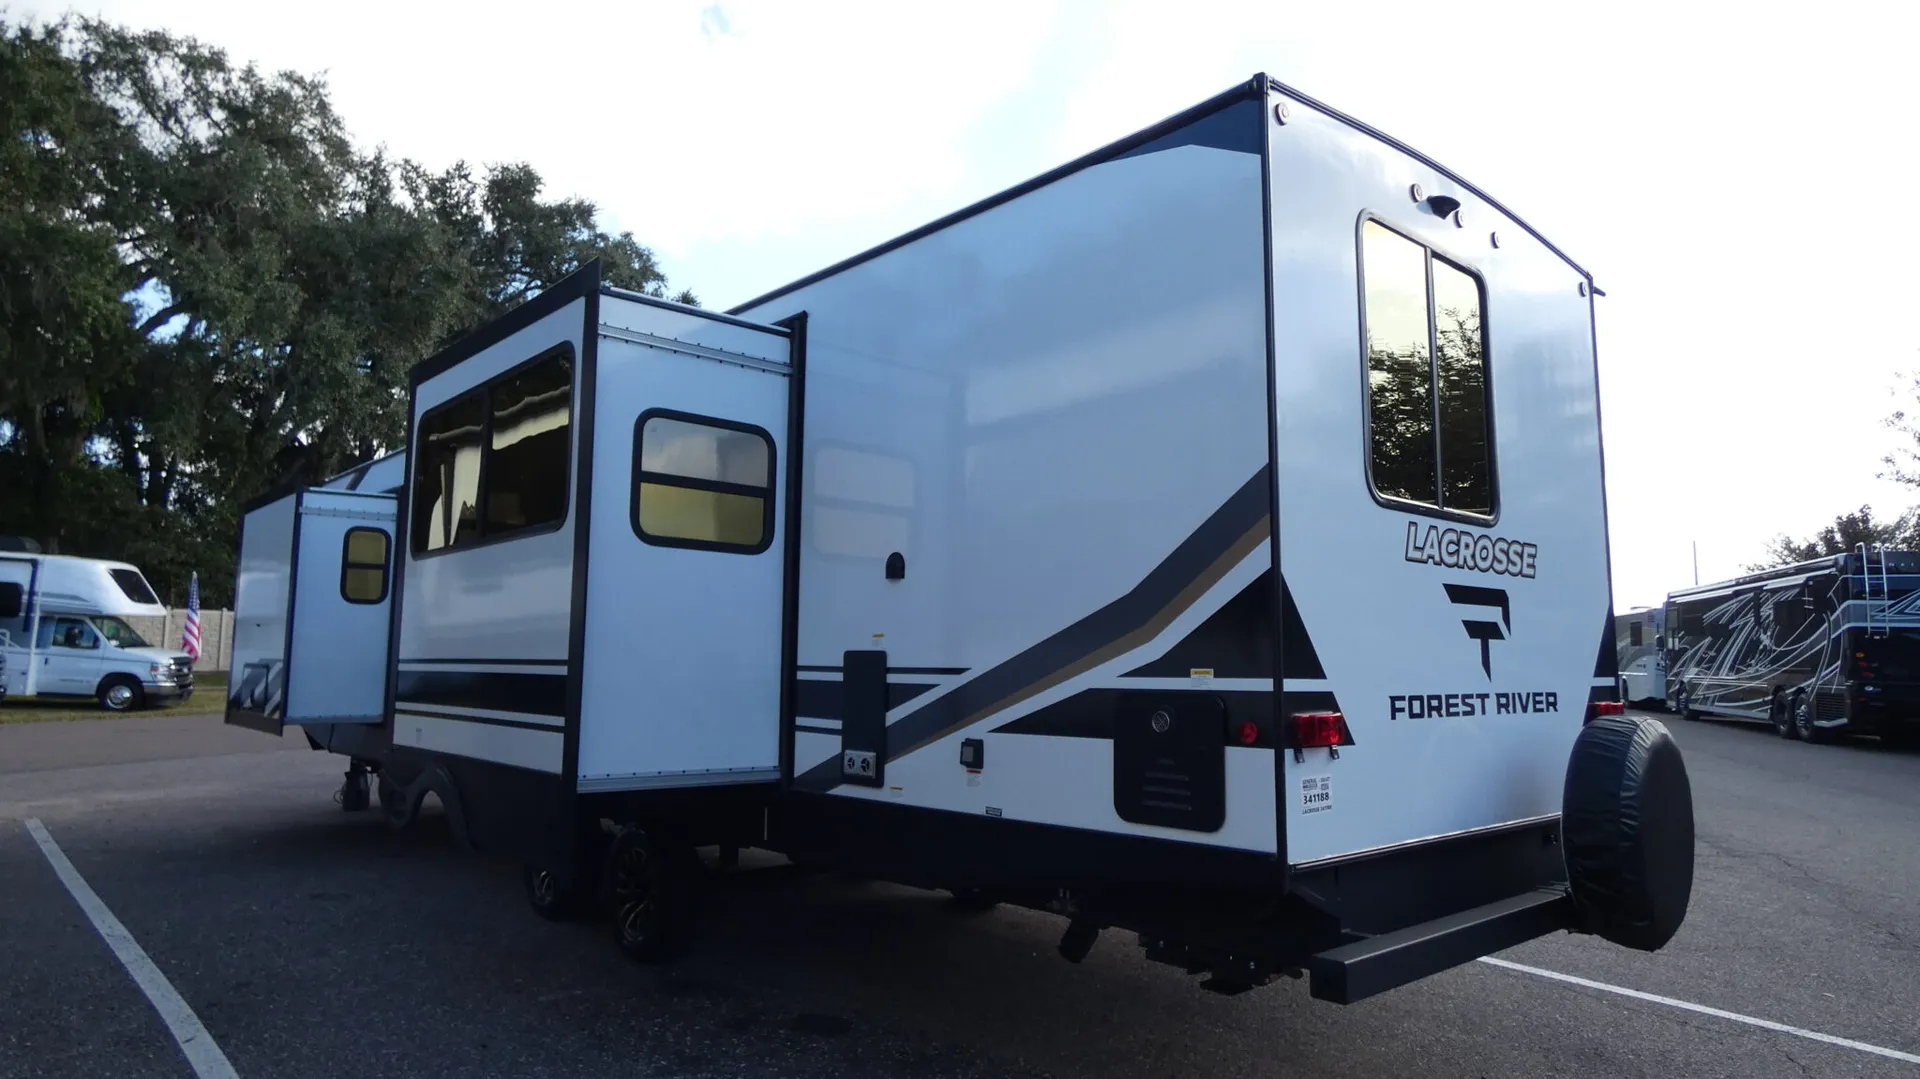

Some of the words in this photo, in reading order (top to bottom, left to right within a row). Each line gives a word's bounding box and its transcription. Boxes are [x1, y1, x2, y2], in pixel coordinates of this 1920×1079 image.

[1405, 521, 1537, 579] LACROSSE
[1389, 693, 1490, 720] FOREST
[1495, 692, 1558, 715] RIVER
[1303, 792, 1329, 804] 341188
